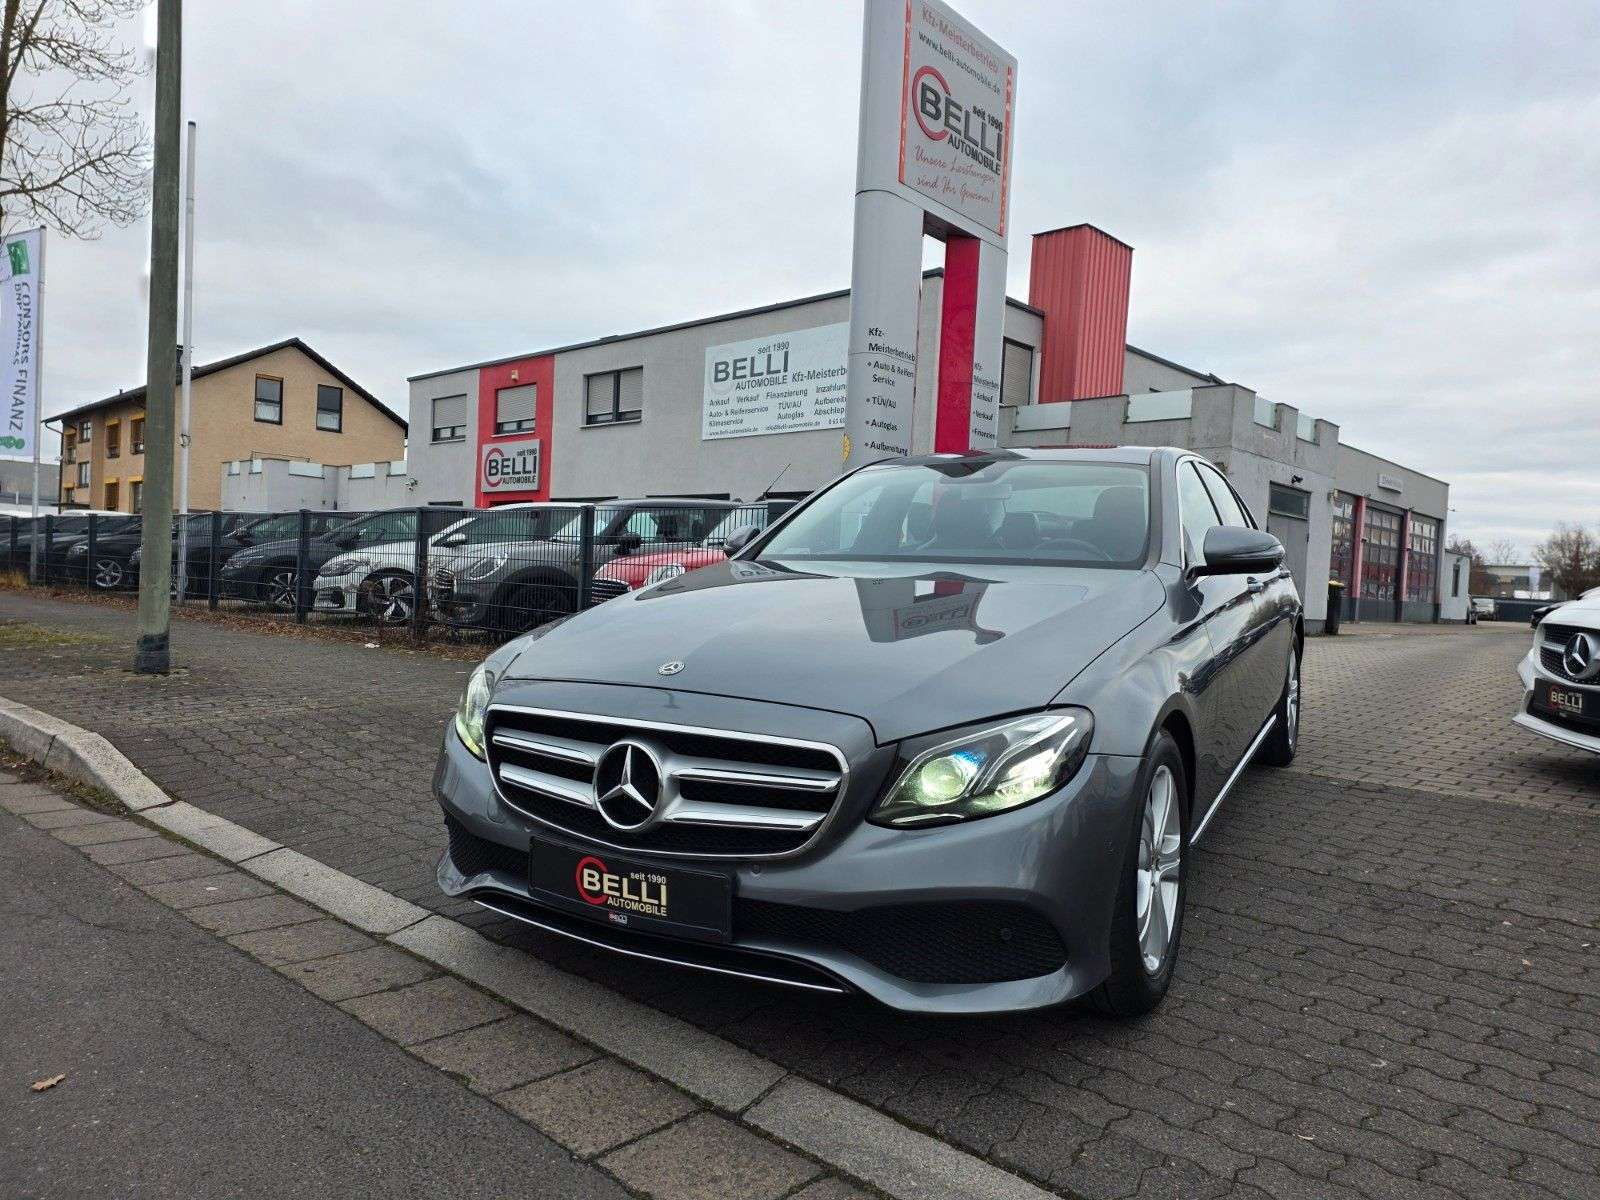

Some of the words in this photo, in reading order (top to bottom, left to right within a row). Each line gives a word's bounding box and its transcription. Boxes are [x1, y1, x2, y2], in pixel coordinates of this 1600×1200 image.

[920, 81, 1003, 161] BELLI
[987, 113, 1003, 132] 1990
[947, 133, 1001, 176] AUTOMOBILE
[20, 281, 31, 365] CONSORS
[757, 345, 772, 354] seit
[773, 341, 790, 352] 1990
[713, 350, 789, 383] BELLI
[735, 375, 788, 391] AUTOMOBILE
[9, 369, 28, 432] FINANZ
[869, 440, 909, 457] Aufbereitung
[488, 456, 537, 476] BELLI
[502, 475, 537, 485] AUTOMOBILE
[1551, 691, 1582, 709] BELLI
[583, 868, 668, 906] BELLI
[630, 871, 646, 882] seit
[647, 873, 667, 885] 1990
[607, 896, 668, 917] AUTOMOBILE
